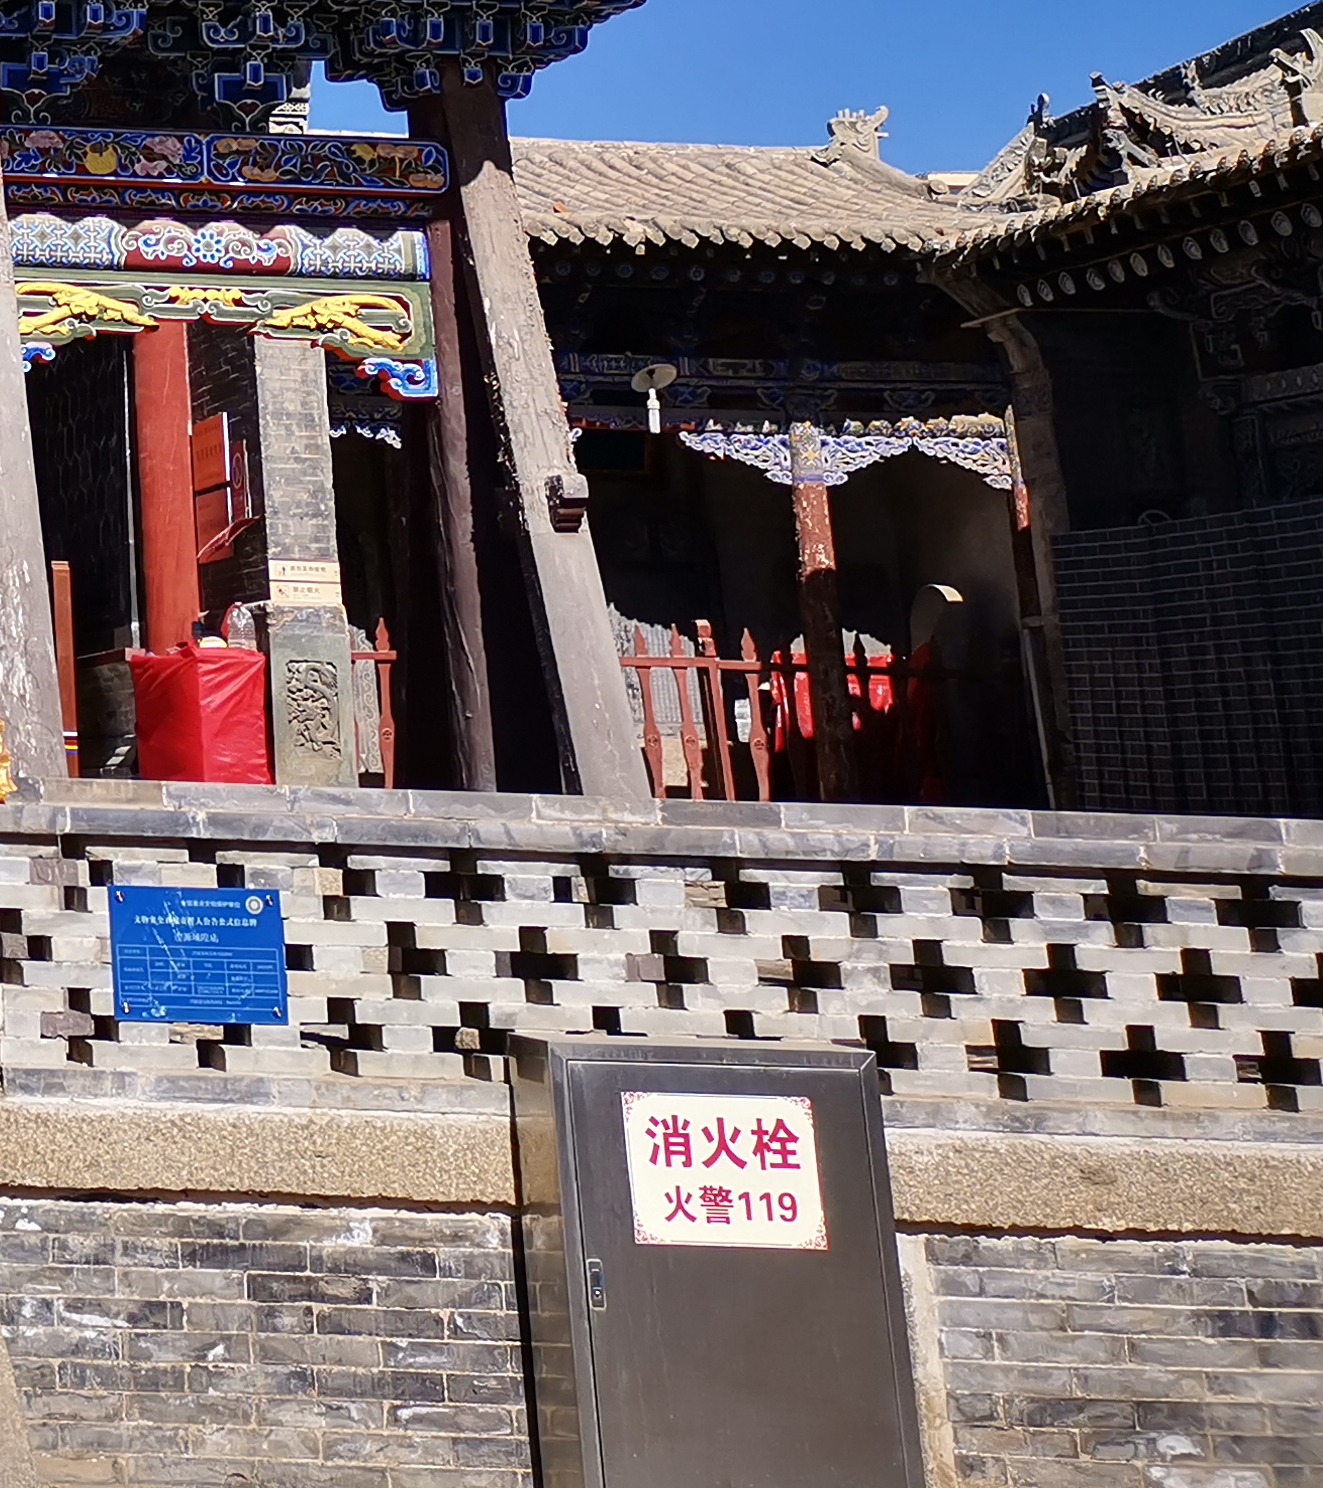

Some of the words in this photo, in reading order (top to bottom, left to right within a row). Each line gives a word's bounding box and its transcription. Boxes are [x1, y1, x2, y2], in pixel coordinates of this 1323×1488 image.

[644, 1114, 802, 1171] 消火栓
[663, 1184, 798, 1225] 火警119
